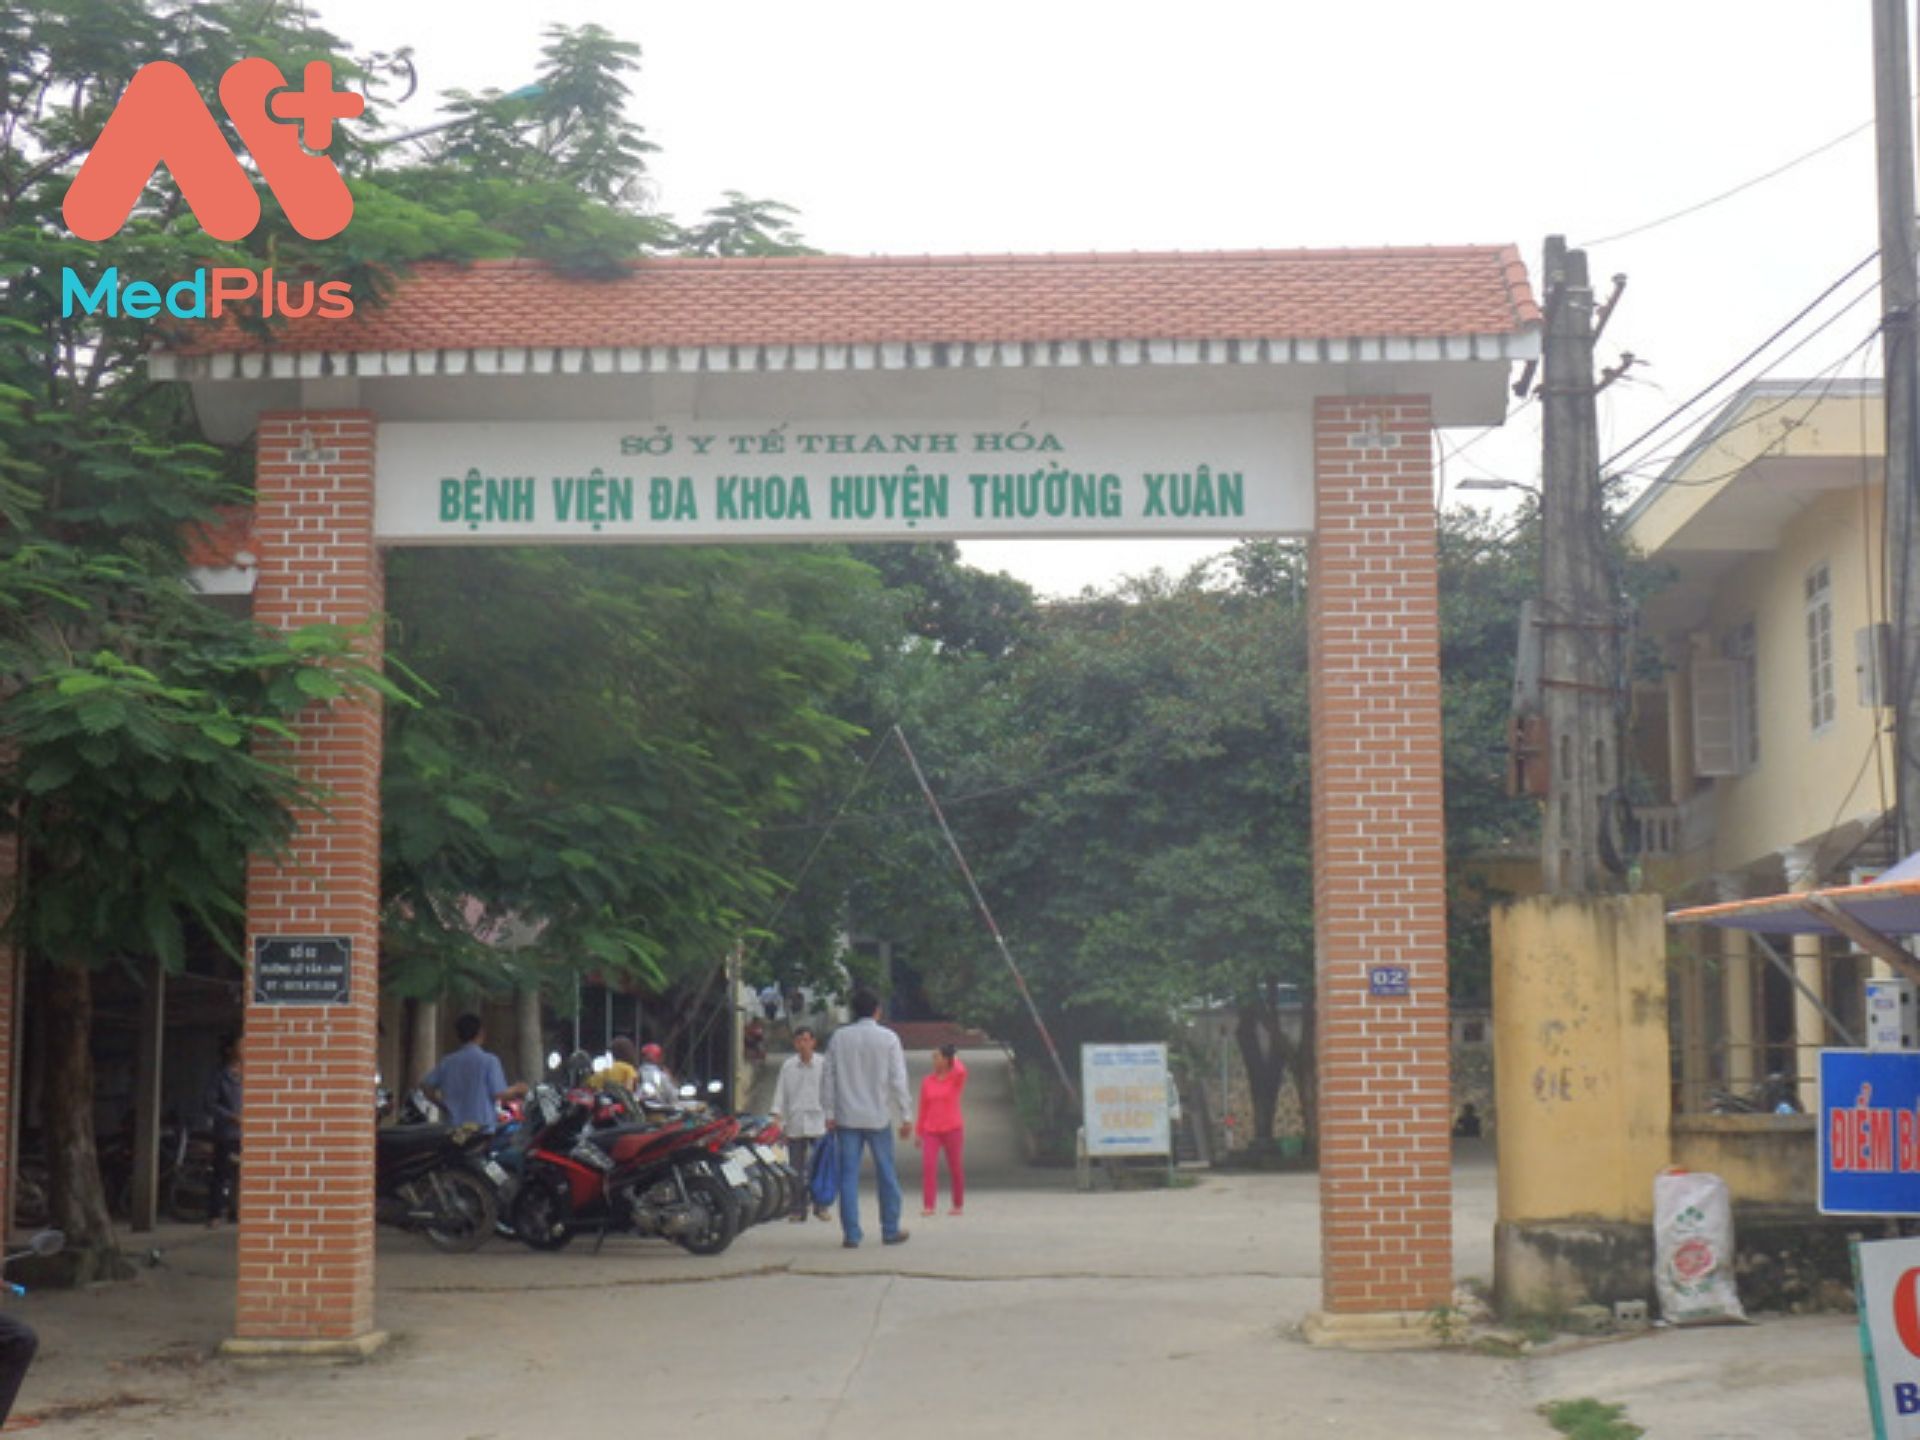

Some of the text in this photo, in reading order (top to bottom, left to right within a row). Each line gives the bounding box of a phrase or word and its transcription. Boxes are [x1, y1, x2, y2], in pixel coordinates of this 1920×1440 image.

[620, 420, 1064, 455] SỞ Y TẾ THANH HÓA
[439, 460, 1245, 531] BỆNH VIỆN ĐA KHOA HUYỆN THƯỜNG XUÂN
[1373, 971, 1404, 986] 02
[1831, 1081, 1920, 1173] ĐIỂM B
